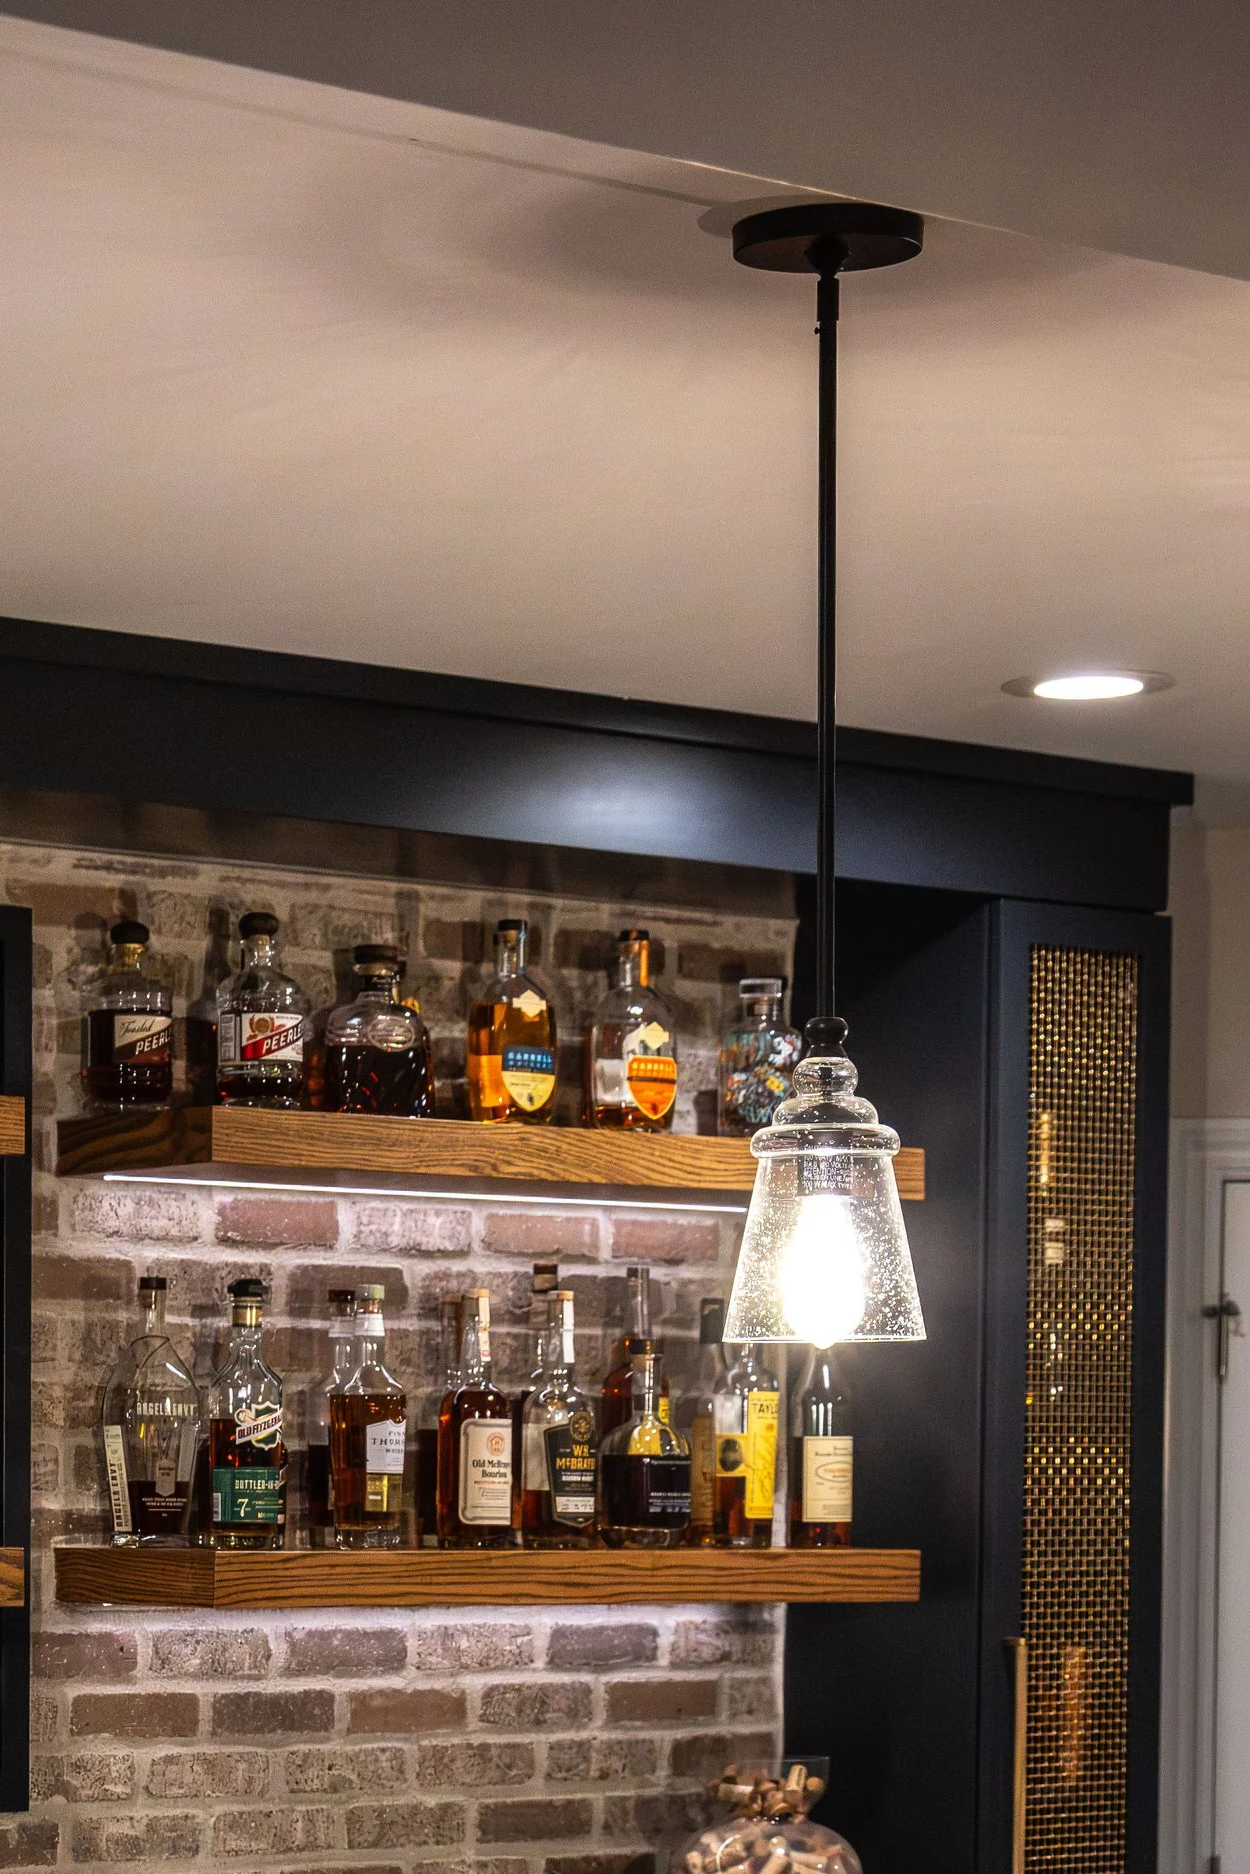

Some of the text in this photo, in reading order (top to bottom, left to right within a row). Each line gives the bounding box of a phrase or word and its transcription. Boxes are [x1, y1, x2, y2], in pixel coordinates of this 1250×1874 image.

[135, 1030, 171, 1055] PEERL
[261, 1023, 302, 1055] PEERLE
[237, 1426, 252, 1440] OLD
[371, 1438, 405, 1446] THOM
[472, 1459, 485, 1468] Old
[237, 1498, 249, 1518] 7
